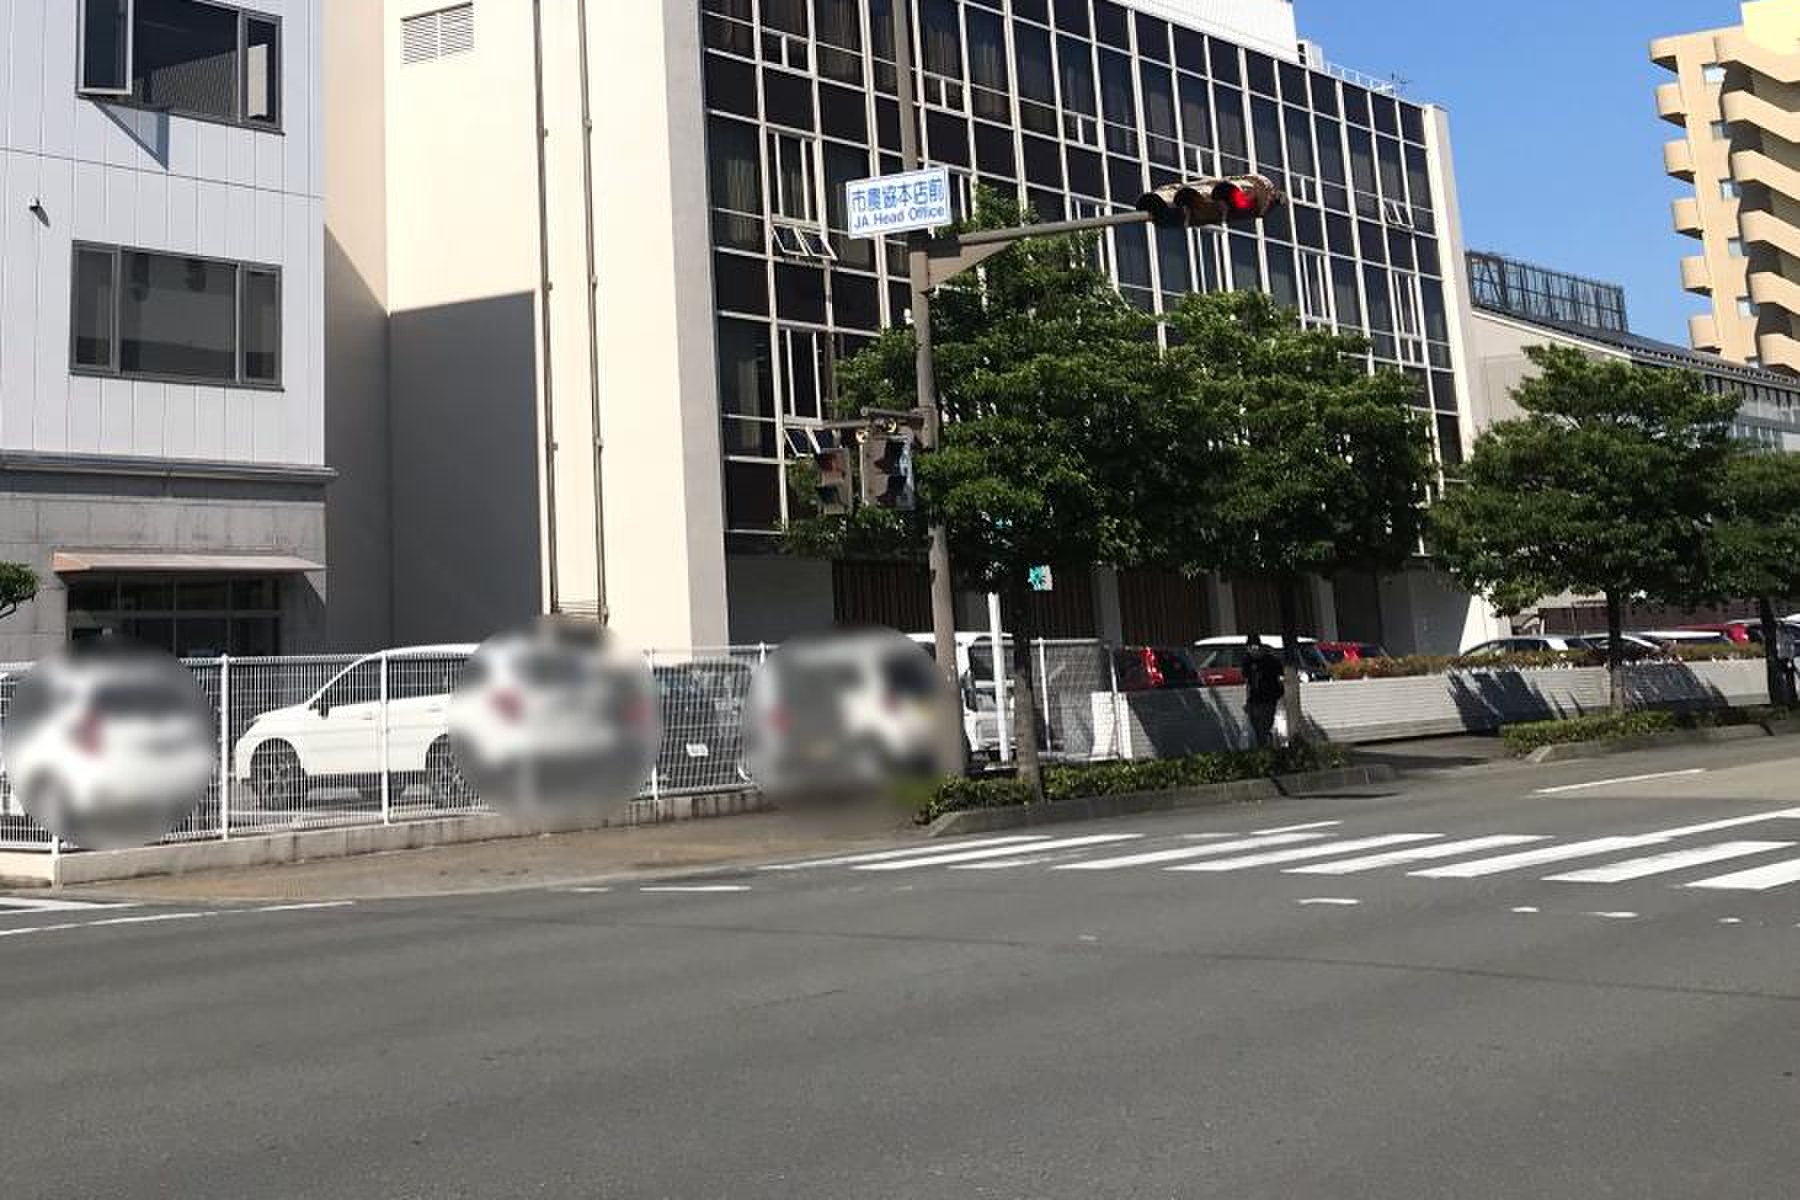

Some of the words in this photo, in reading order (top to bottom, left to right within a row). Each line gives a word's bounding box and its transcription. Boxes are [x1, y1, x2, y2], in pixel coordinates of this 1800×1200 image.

[851, 176, 944, 212] 市農協本店前
[853, 214, 869, 228] JA
[873, 210, 905, 225] Head
[908, 206, 945, 221] Office
